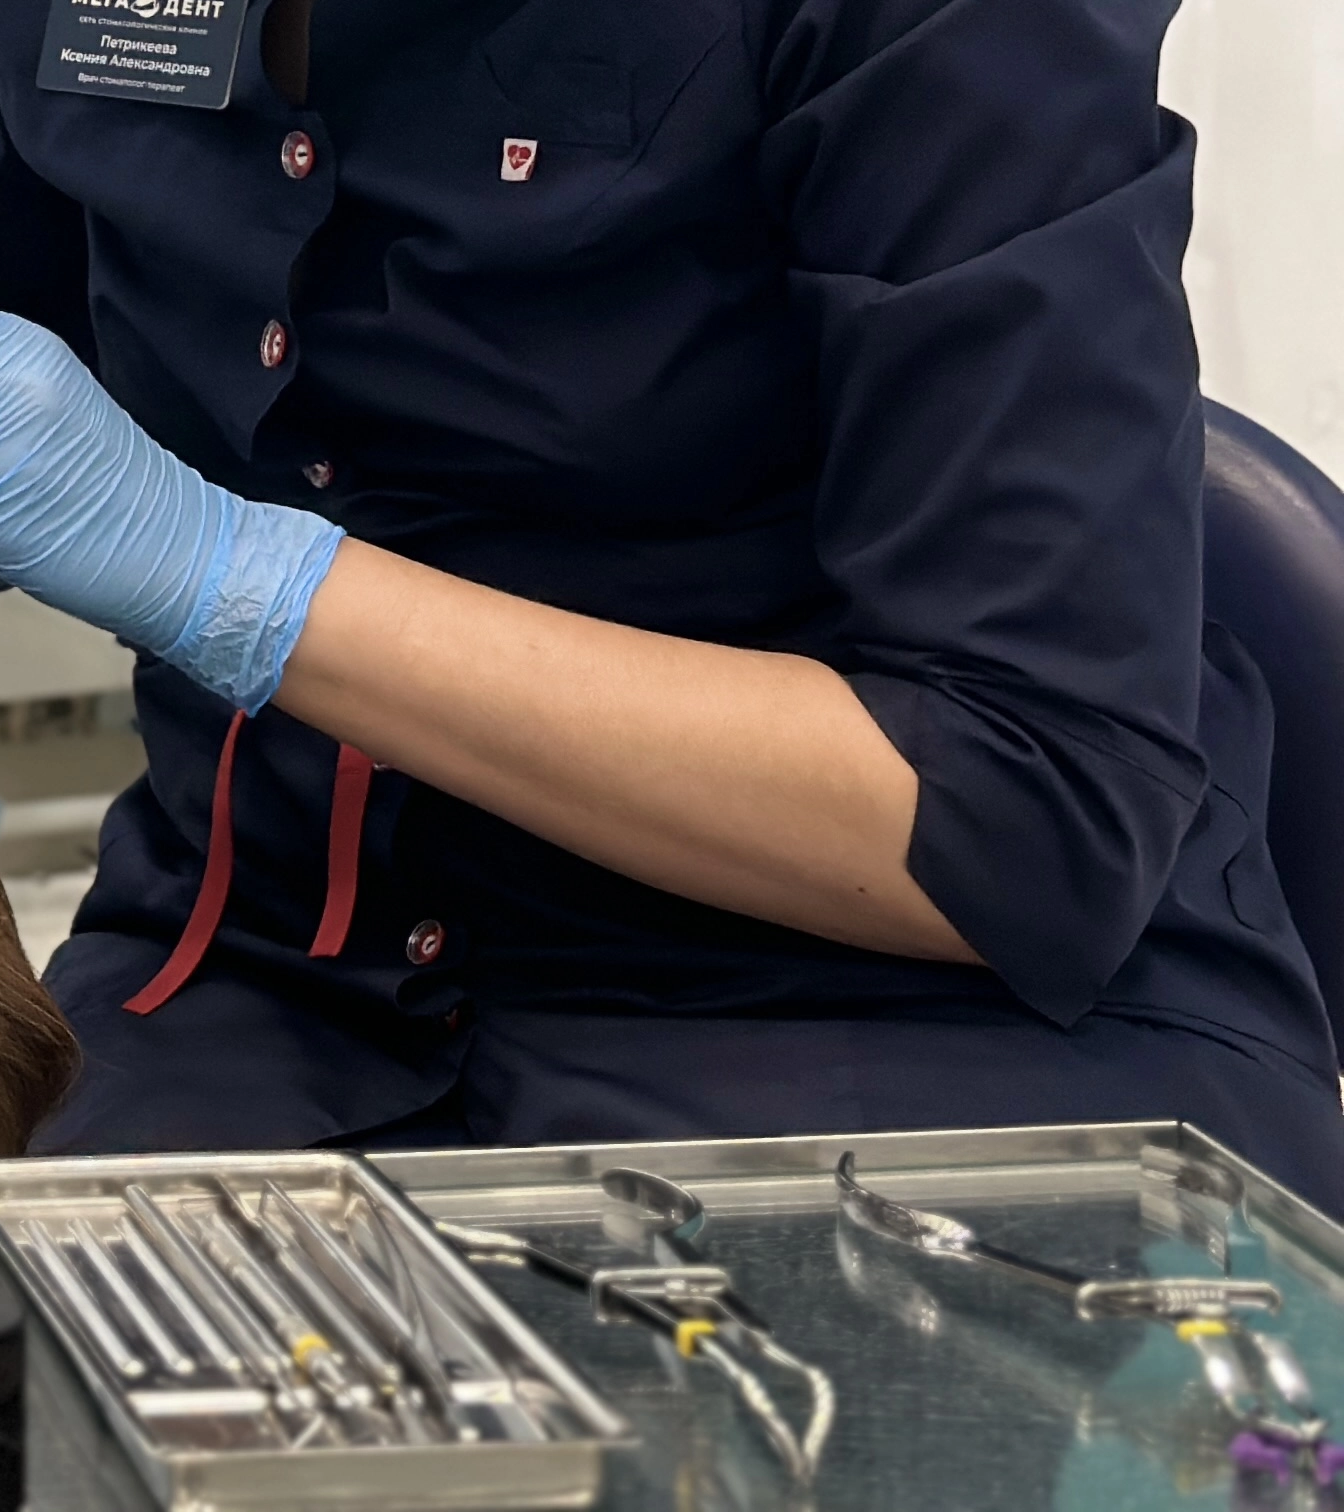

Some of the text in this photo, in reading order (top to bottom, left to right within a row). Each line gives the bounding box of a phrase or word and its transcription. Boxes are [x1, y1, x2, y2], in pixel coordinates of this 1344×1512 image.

[100, 34, 178, 56] Петрикеева
[60, 48, 211, 77] Ксения Александровна
